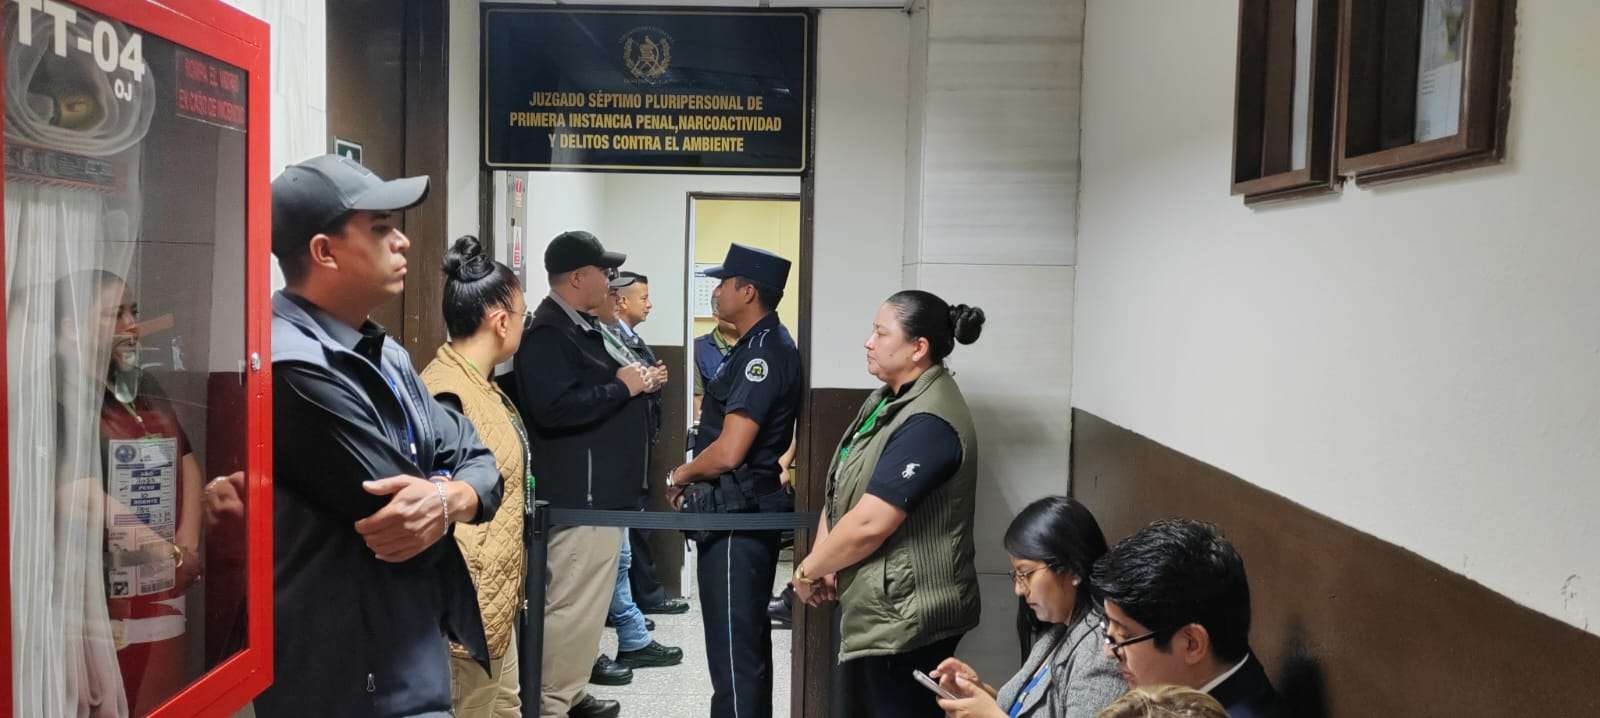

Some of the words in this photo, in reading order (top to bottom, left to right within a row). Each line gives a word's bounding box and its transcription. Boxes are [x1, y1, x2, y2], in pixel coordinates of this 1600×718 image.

[13, 0, 145, 82] TT-04
[114, 78, 132, 101] OJ
[529, 92, 585, 107] JUZGADO
[588, 90, 641, 108] SÉPTIMO
[645, 94, 744, 110] PLURIPERSONAL
[747, 96, 763, 110] DE
[510, 112, 566, 127] PRIMERA
[569, 113, 632, 129] INSTANCIA
[548, 133, 556, 147] Y
[560, 133, 609, 149] DELITOS
[613, 134, 661, 151] CONTRA
[665, 136, 679, 151] EL
[682, 136, 744, 152] AMBIENTE
